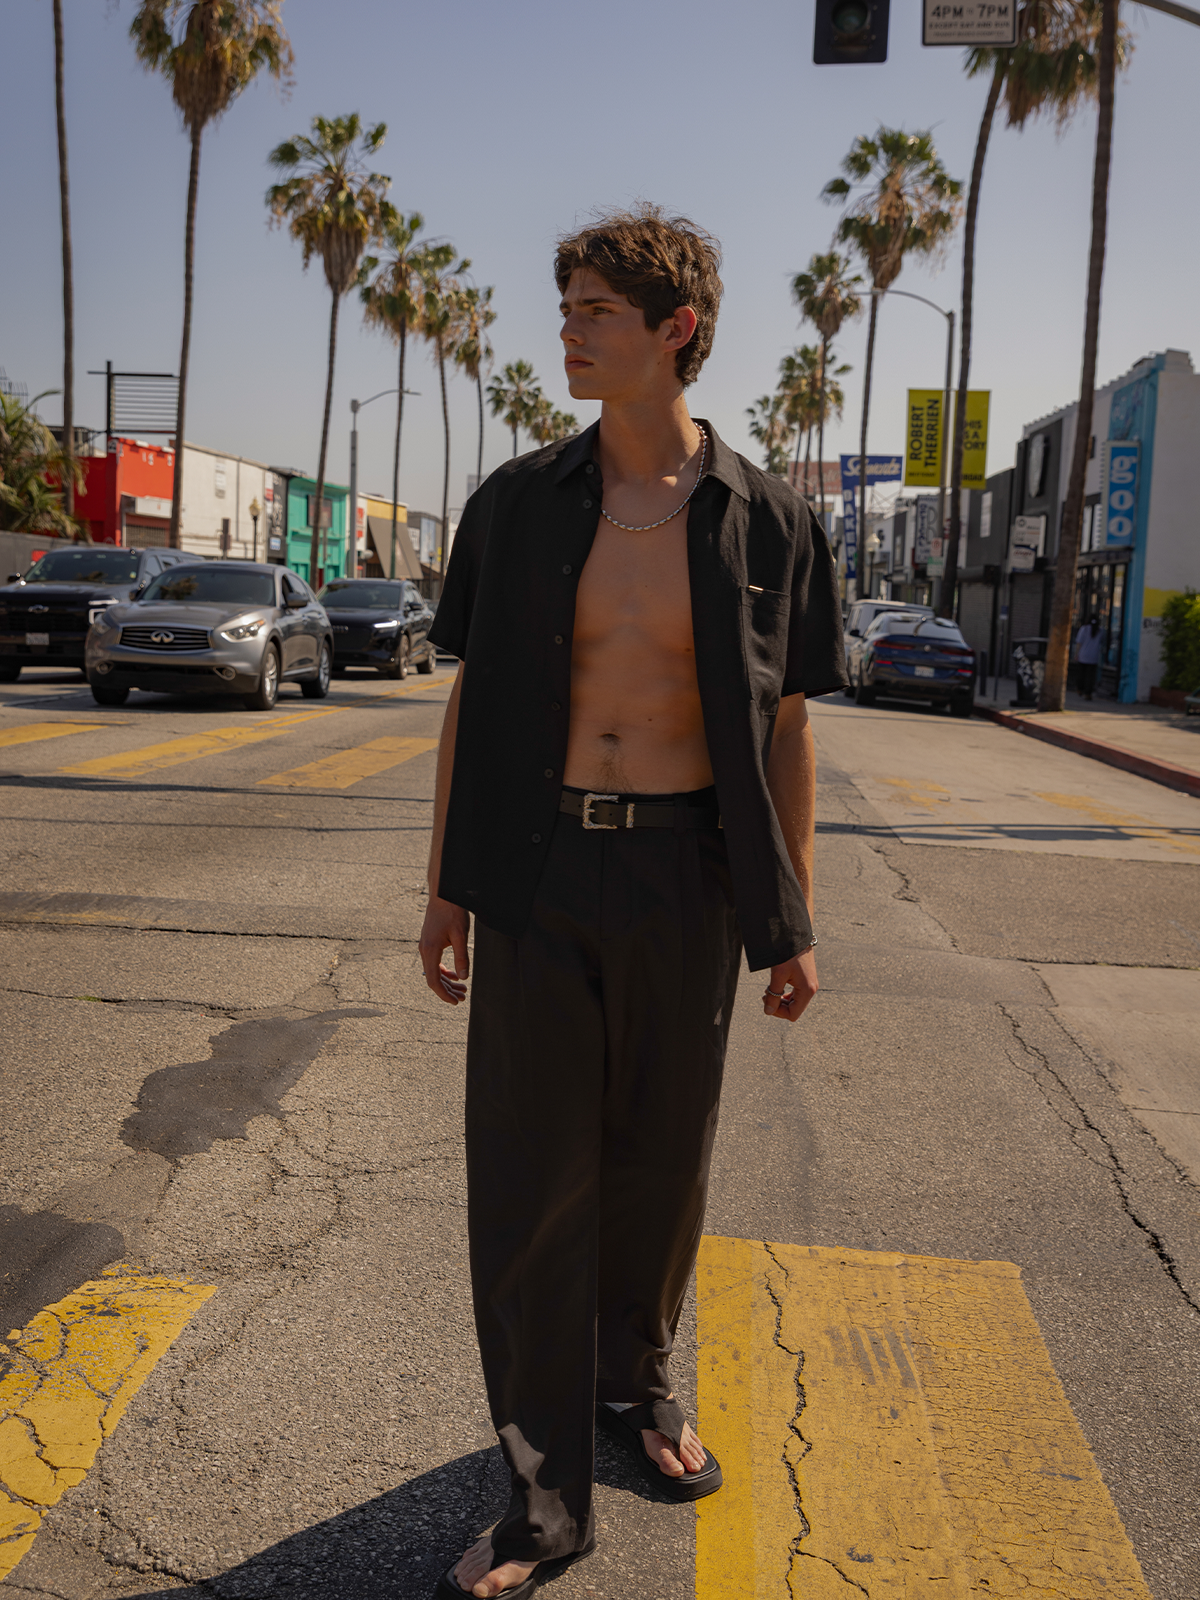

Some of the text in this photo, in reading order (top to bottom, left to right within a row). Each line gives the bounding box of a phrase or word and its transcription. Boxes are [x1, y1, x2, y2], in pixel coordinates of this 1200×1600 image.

[930, 3, 964, 19] 4PM
[976, 3, 1009, 19] 7PM
[976, 21, 993, 29] AND
[964, 420, 983, 429] HIS
[909, 405, 924, 461] ROBERT
[924, 399, 940, 467] THERRIEN
[964, 431, 980, 439] S A
[964, 441, 985, 451] ORY
[1108, 455, 1137, 537] goo
[843, 489, 856, 571] BAKERY
